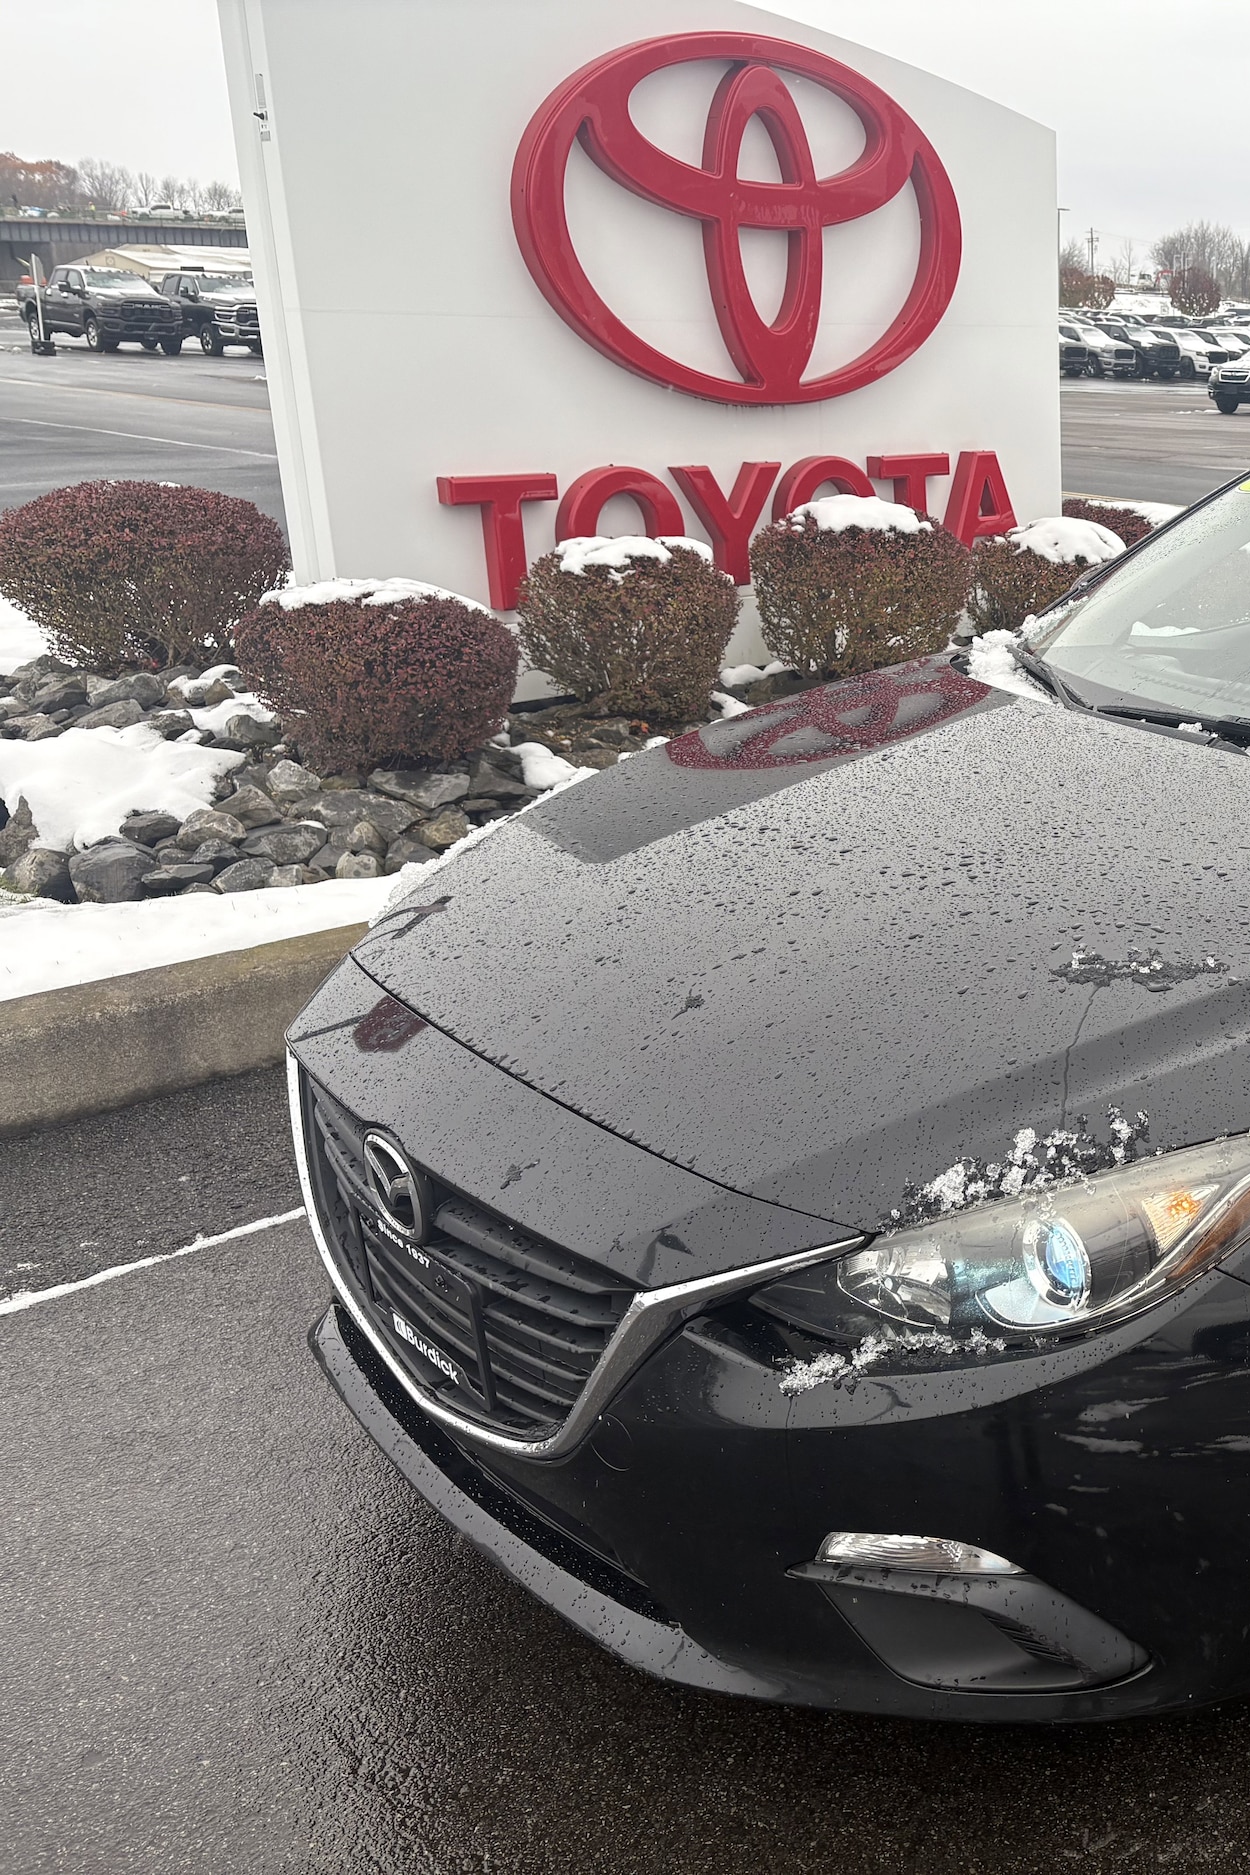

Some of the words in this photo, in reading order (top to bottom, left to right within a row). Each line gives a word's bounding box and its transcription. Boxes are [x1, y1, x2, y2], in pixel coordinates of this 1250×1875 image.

[377, 1219, 404, 1249] Since
[405, 1243, 431, 1269] 1937
[404, 1325, 460, 1385] Burdick
